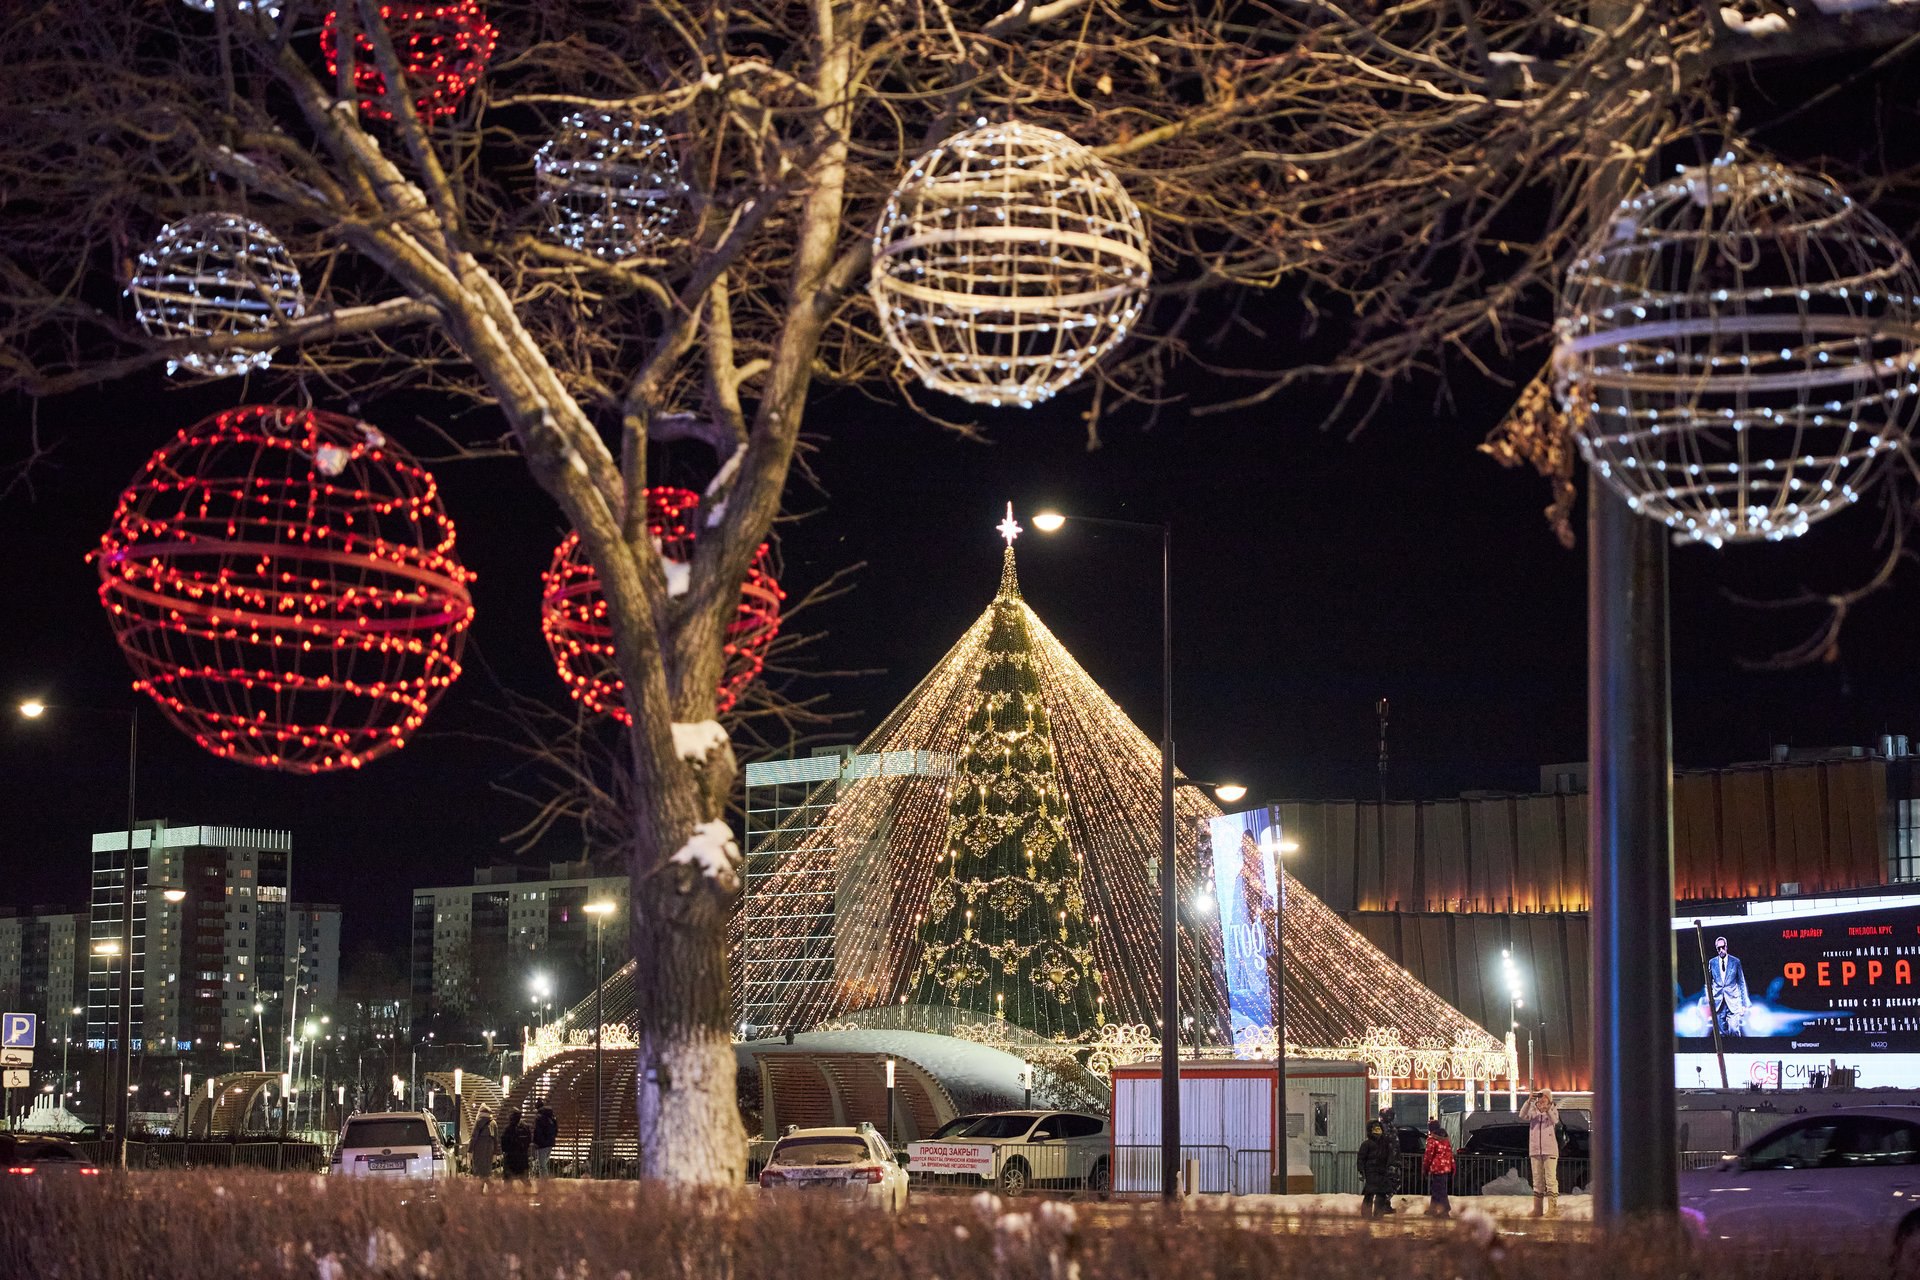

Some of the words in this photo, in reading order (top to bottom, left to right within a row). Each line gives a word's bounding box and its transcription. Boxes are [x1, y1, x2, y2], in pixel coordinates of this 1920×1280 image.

[1782, 929, 1798, 939] АДАМ
[1799, 927, 1823, 939] ДРАЙВЕР
[1848, 926, 1877, 936] ПЕНЕЛОПА
[1878, 925, 1893, 935] КРУС
[1856, 944, 1889, 956] МАЙКЛ
[1783, 959, 1912, 987] ФЕРРА
[1829, 999, 1833, 1008] В
[1838, 998, 1858, 1008] КИНО
[1863, 998, 1867, 1007] С
[1872, 998, 1881, 1007] 21
[920, 1146, 948, 1156] ПРОХОД
[949, 1147, 979, 1157] ЗАКРЫТ!
